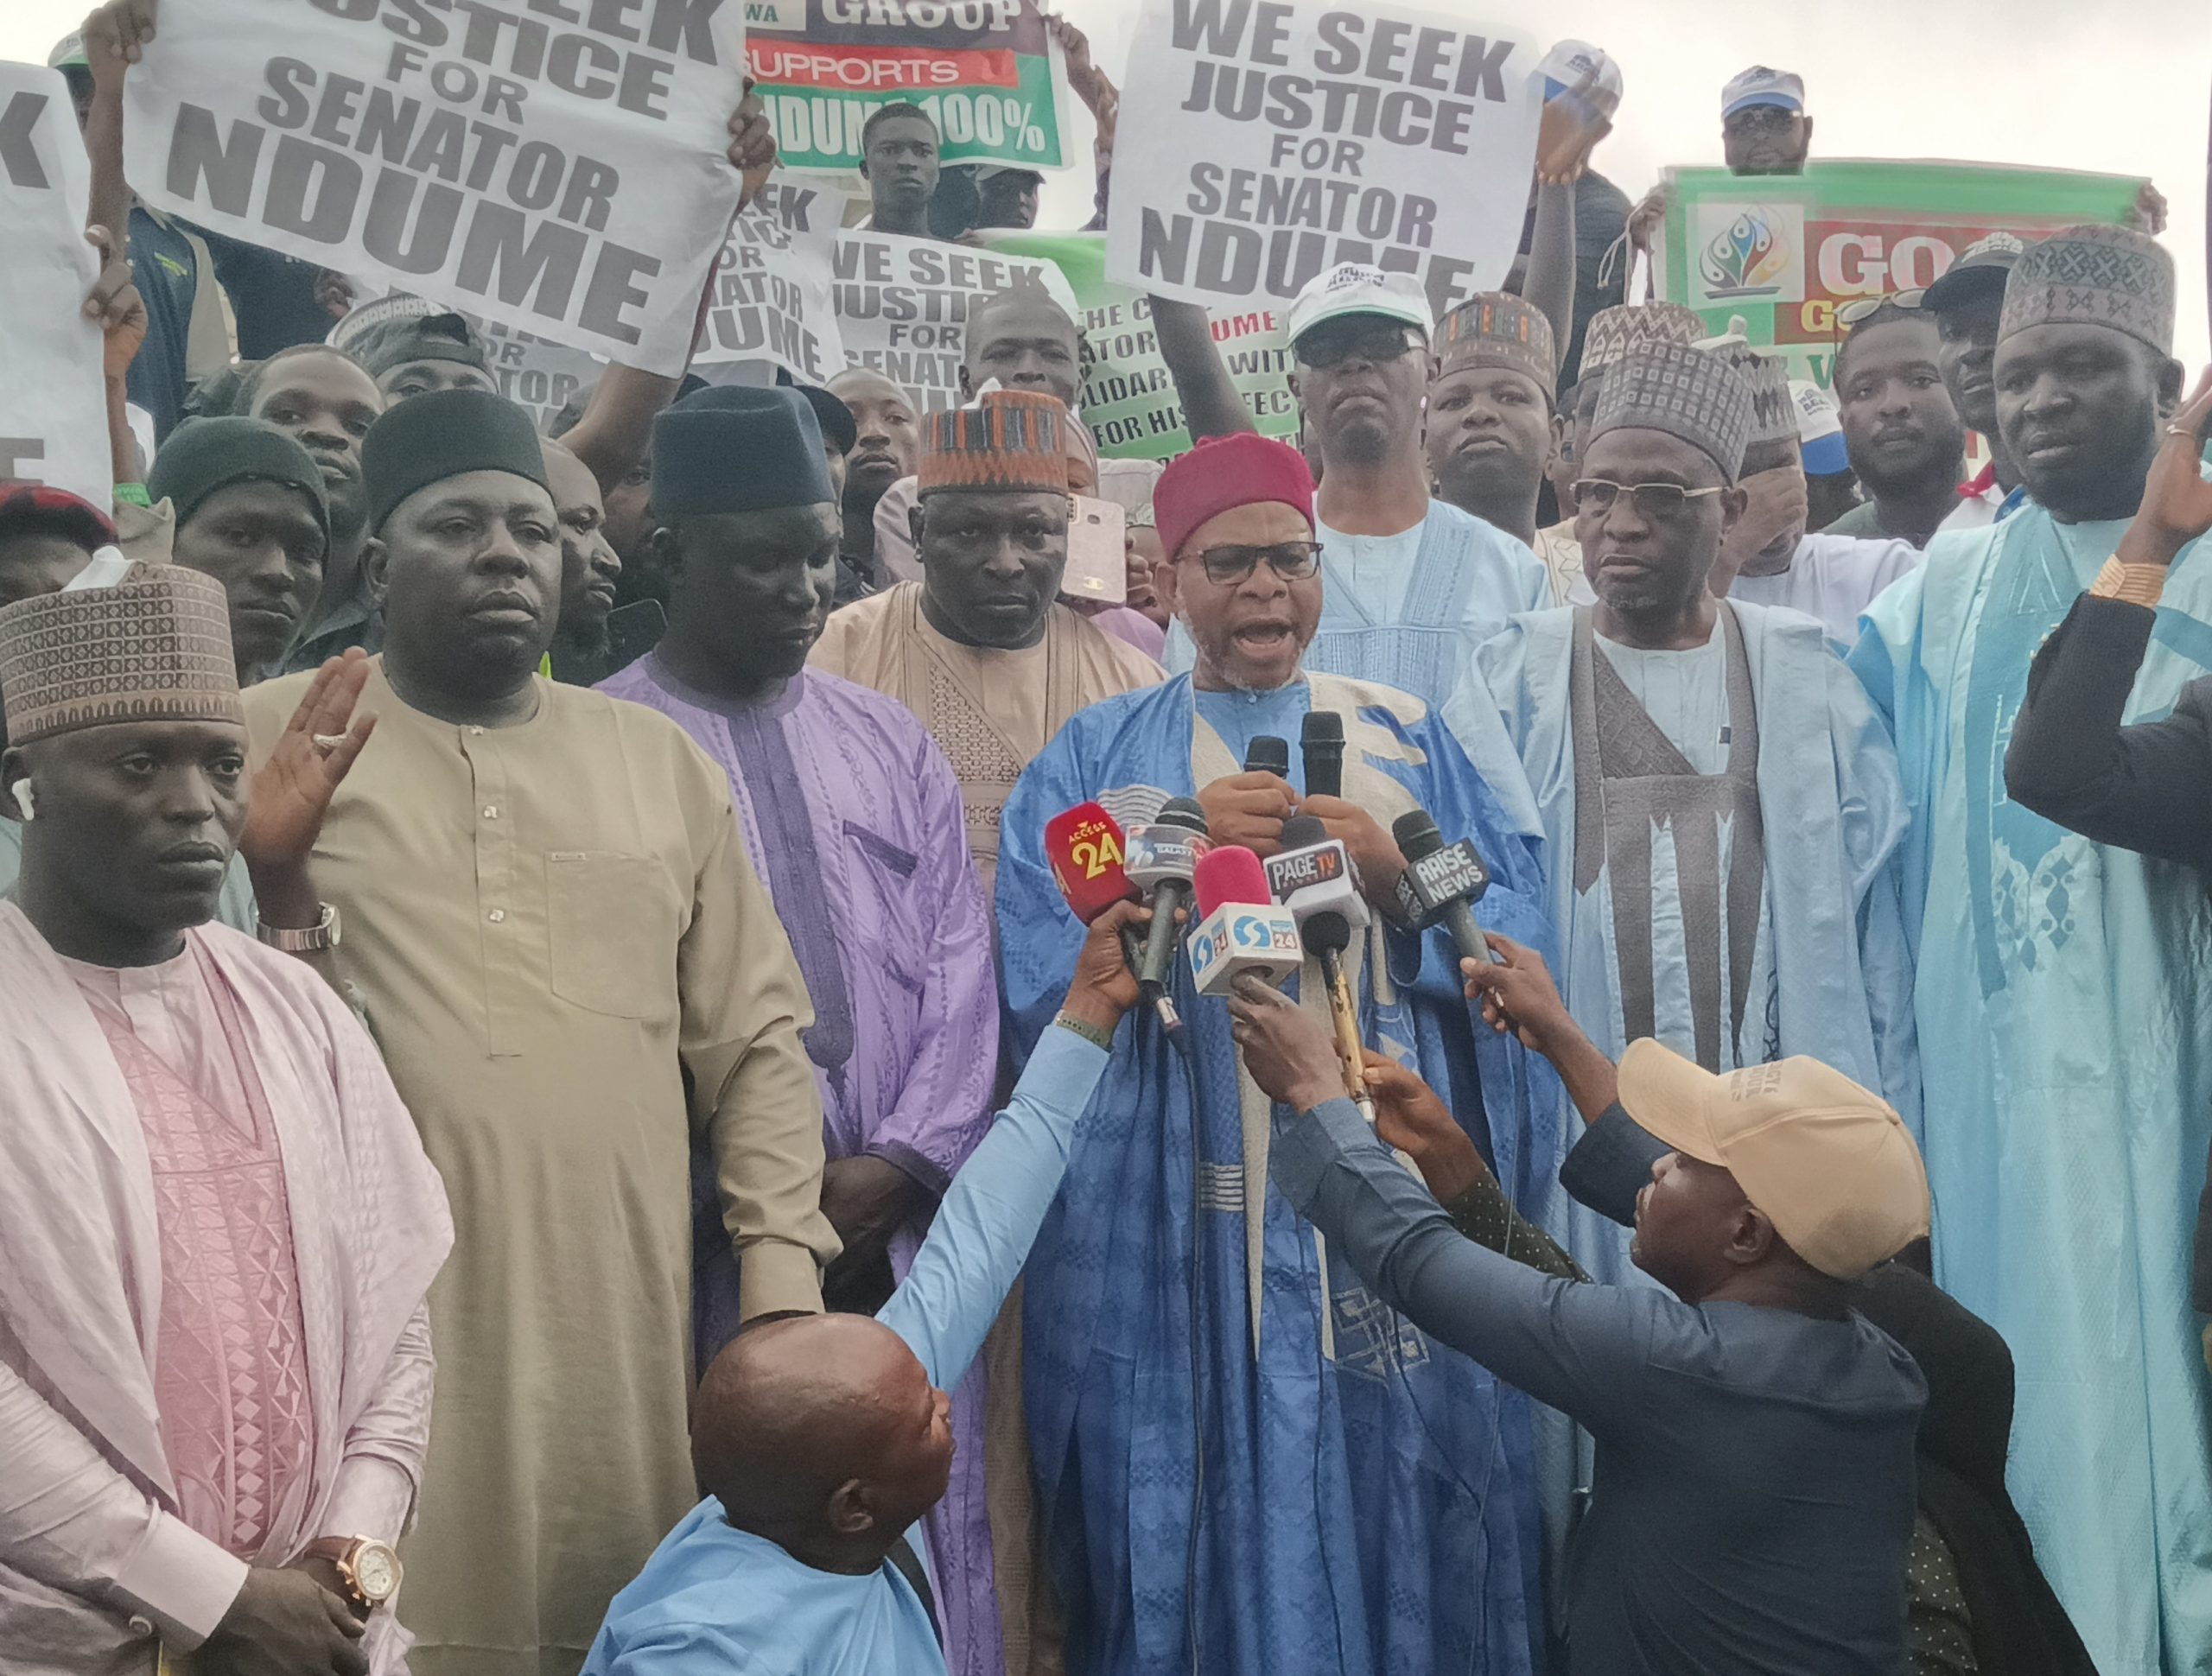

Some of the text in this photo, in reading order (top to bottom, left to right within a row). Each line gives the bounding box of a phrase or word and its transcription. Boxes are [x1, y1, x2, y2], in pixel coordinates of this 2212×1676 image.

[1172, 0, 1516, 103] WE SEEK
[385, 41, 529, 125] FOR
[1180, 60, 1474, 155] JUSTICE
[257, 56, 620, 232] SENATOR
[1269, 133, 1365, 176] FOR
[166, 101, 662, 346] NDUME
[1186, 162, 1438, 249] SENATOR
[889, 324, 963, 350] FOR
[1228, 349, 1287, 375] WIT
[1092, 416, 1143, 448] FOR
[1072, 833, 1123, 879] 24
[1273, 854, 1318, 890] PAGE
[1317, 853, 1335, 873] TV
[1416, 842, 1471, 885] ARISE
[1427, 865, 1483, 903] NEWS
[1274, 933, 1296, 948] 24
